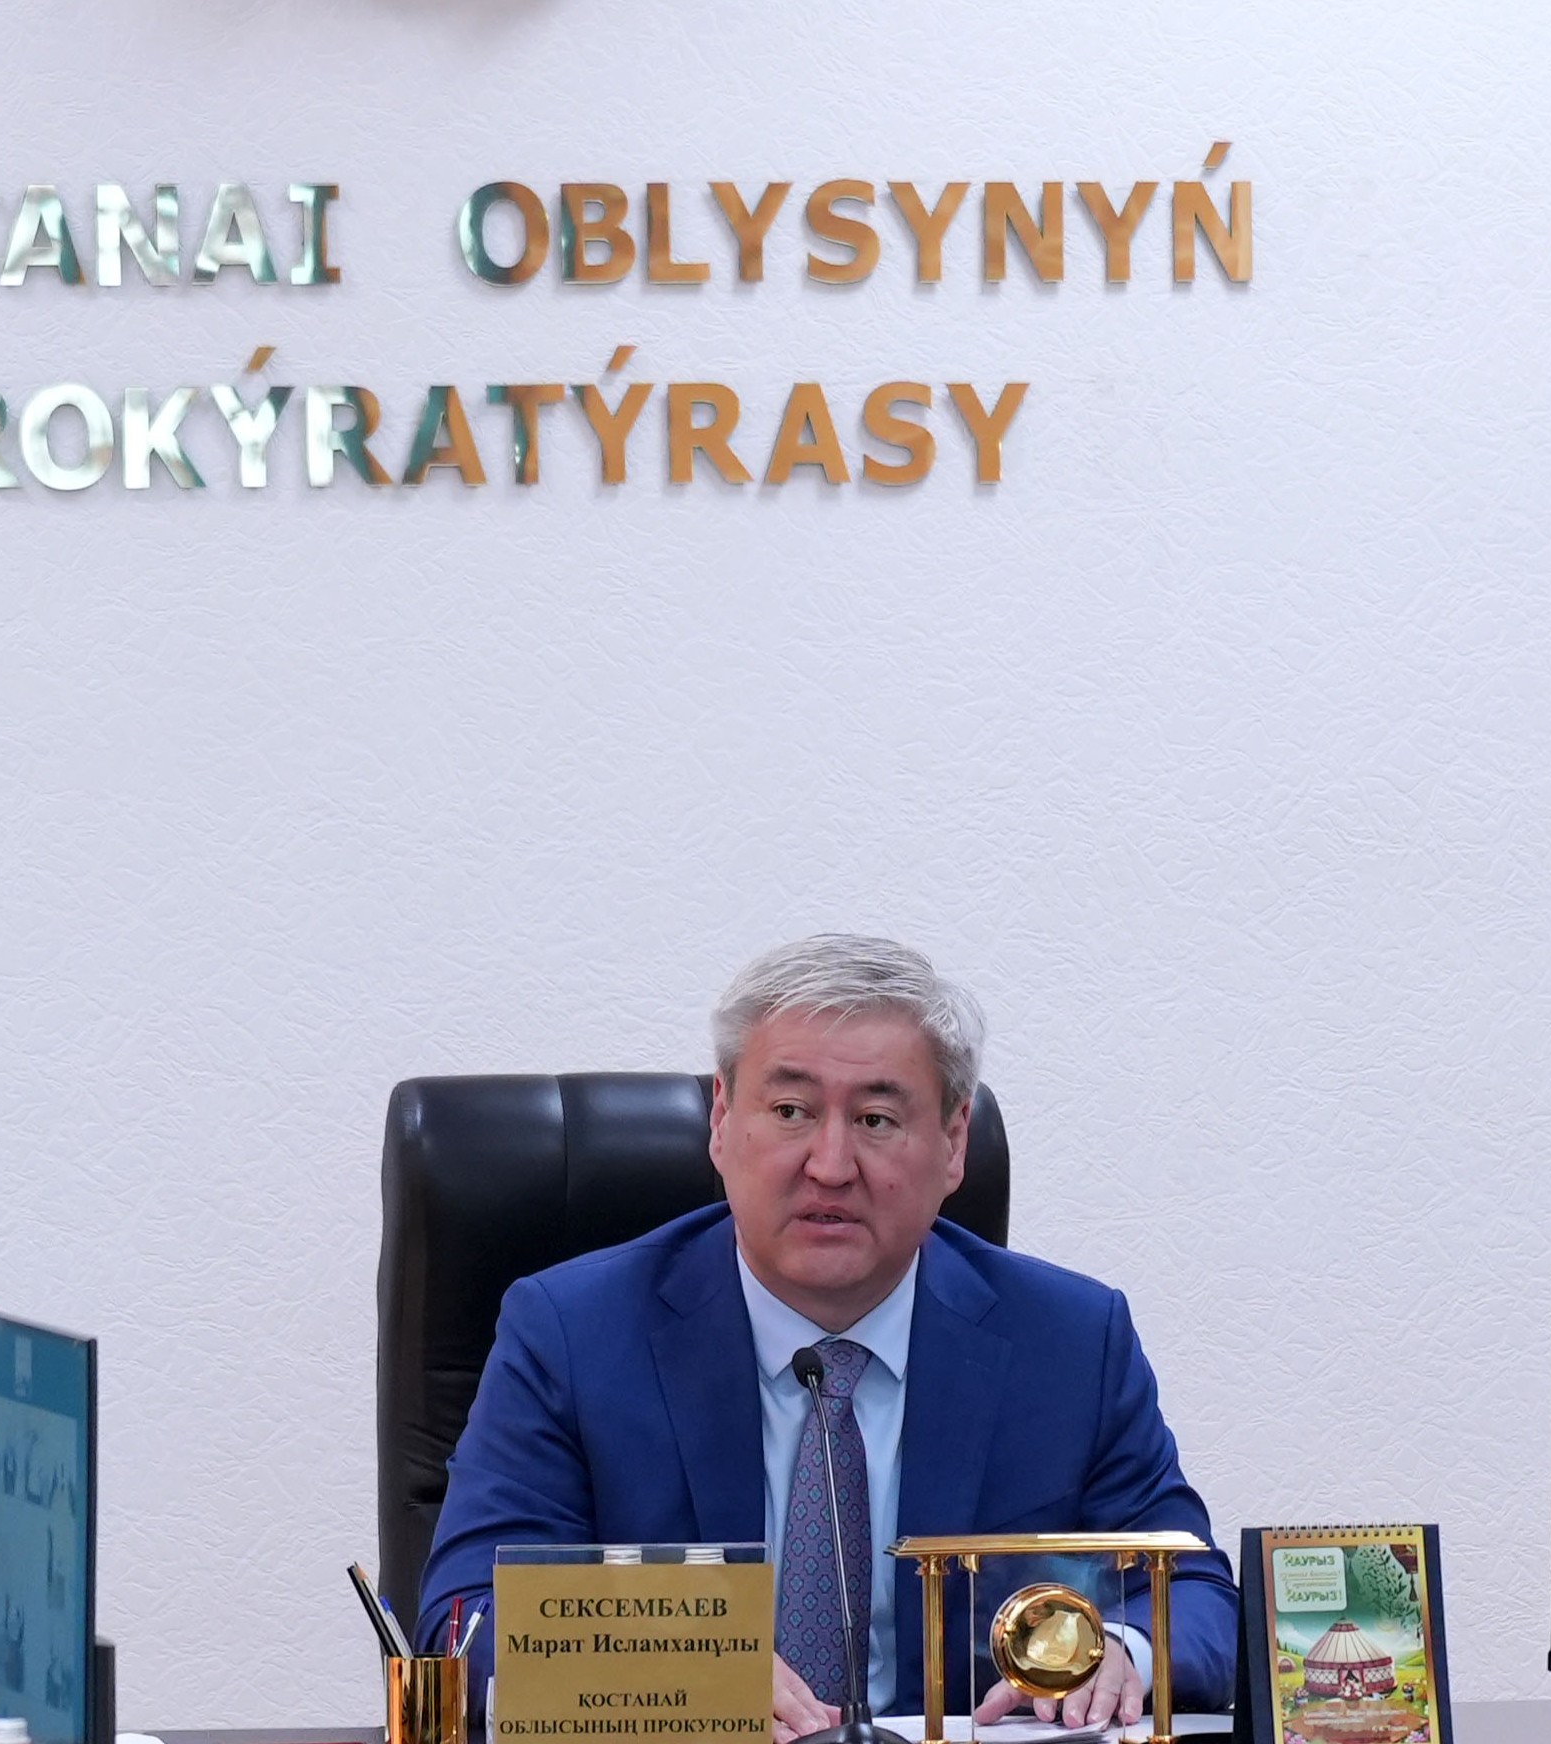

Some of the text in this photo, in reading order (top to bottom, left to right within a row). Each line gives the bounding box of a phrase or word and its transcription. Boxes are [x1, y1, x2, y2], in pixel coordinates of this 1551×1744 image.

[456, 140, 1253, 288] OBLYSYNYŃ
[539, 1597, 728, 1619] СЕКСЕМБАЕВ
[507, 1633, 760, 1659] Марат Исламханұлы
[577, 1688, 688, 1711] ҚОСТАНАЙ
[499, 1717, 766, 1737] ОБЛЫСЫНЫҢ ПРОКУРОРЫ
